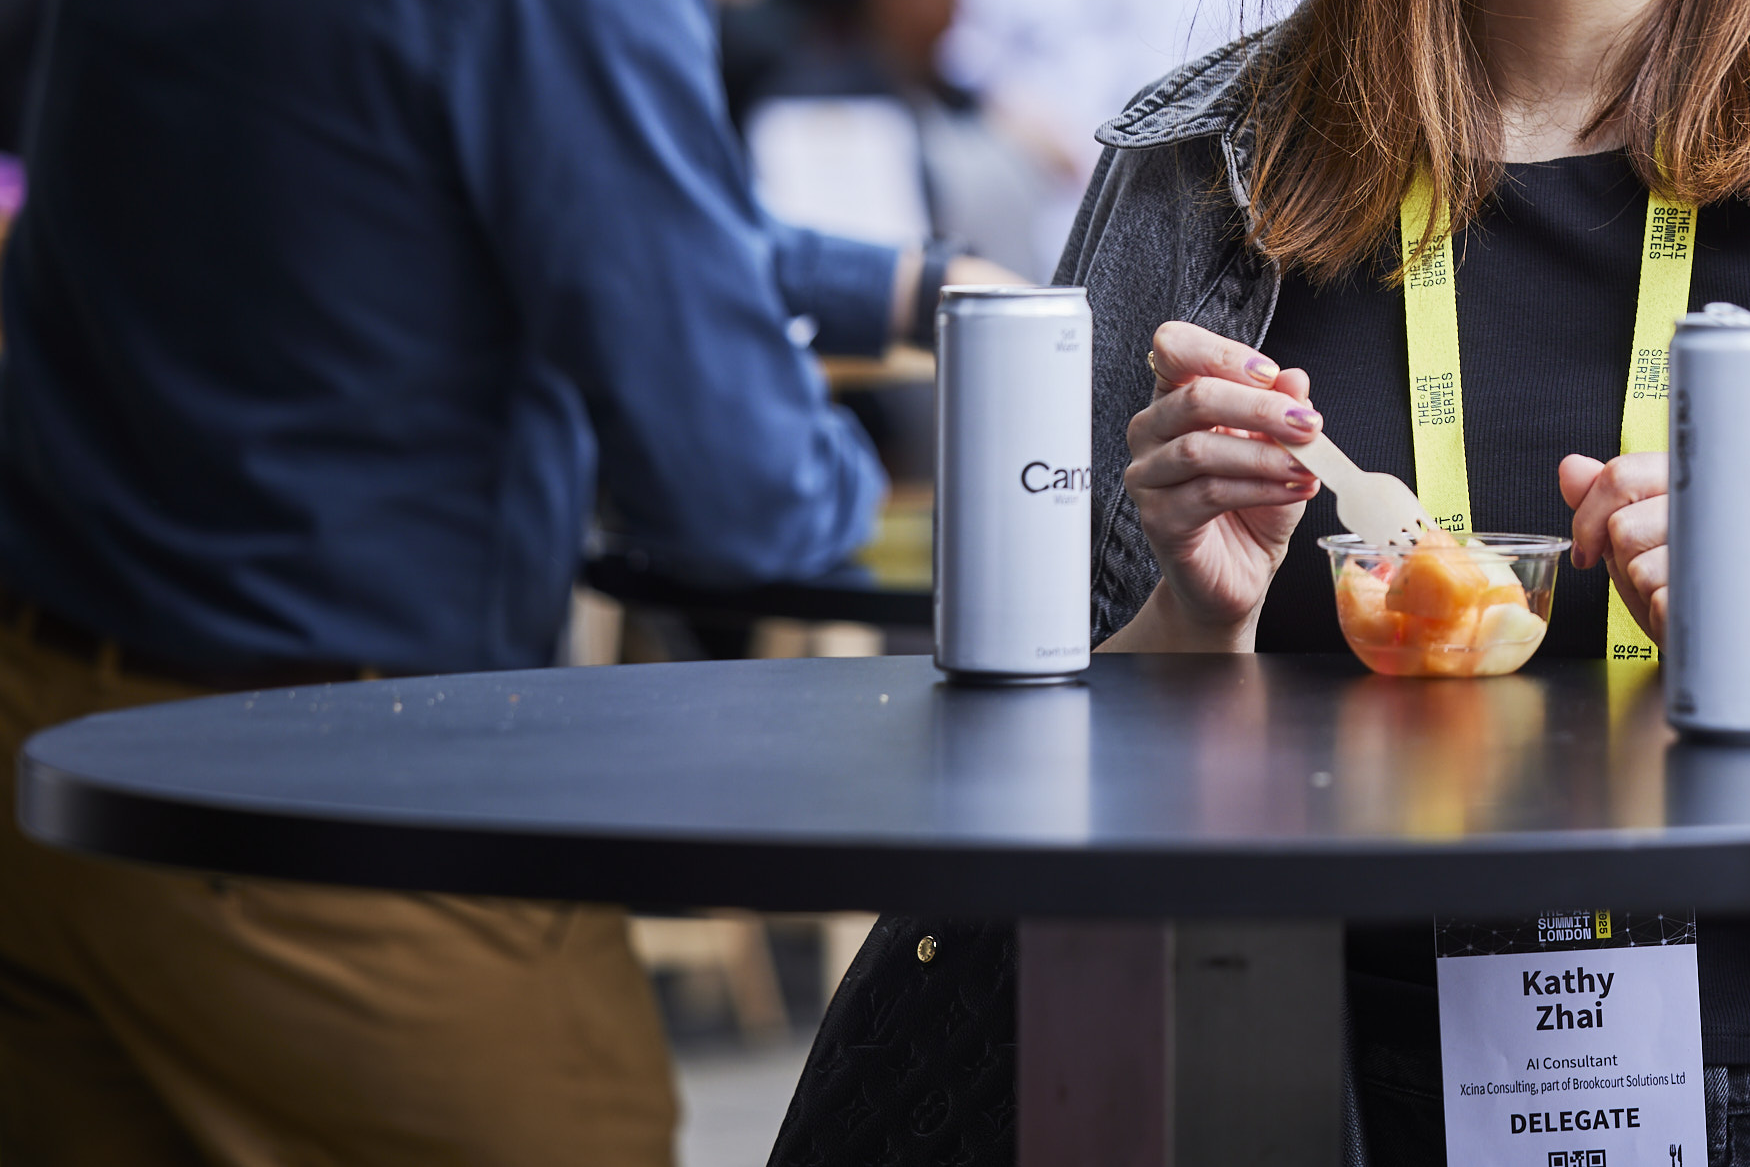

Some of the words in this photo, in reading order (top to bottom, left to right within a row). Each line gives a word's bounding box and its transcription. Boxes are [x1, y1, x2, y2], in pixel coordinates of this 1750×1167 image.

[1649, 207, 1666, 259] SERIES
[1662, 207, 1679, 260] SUMMIT
[1677, 208, 1692, 234] THE
[1421, 239, 1434, 288] SUMMI
[1674, 243, 1688, 260] AI
[1416, 375, 1428, 392] AI
[1633, 348, 1650, 399] SERIES
[1646, 349, 1663, 400] SUMMIT
[1429, 375, 1443, 425] SUMMIT
[1441, 372, 1456, 424] SERIES
[1417, 402, 1430, 426] THE
[1537, 915, 1591, 930] SUMMIT
[1538, 927, 1592, 943] LONDON
[1522, 966, 1615, 999] Kathy
[1536, 1000, 1603, 1031] Zhai
[1526, 1057, 1540, 1071] AI
[1542, 1054, 1619, 1070] Consultant
[1460, 1082, 1486, 1096] Xcina
[1486, 1080, 1539, 1096] Consulting,
[1541, 1079, 1560, 1094] part
[1561, 1077, 1571, 1091] of
[1572, 1076, 1625, 1091] Brookcourt
[1626, 1073, 1669, 1088] Solutions
[1670, 1071, 1686, 1085] Ltd
[1510, 1108, 1641, 1134] DELEGATE
